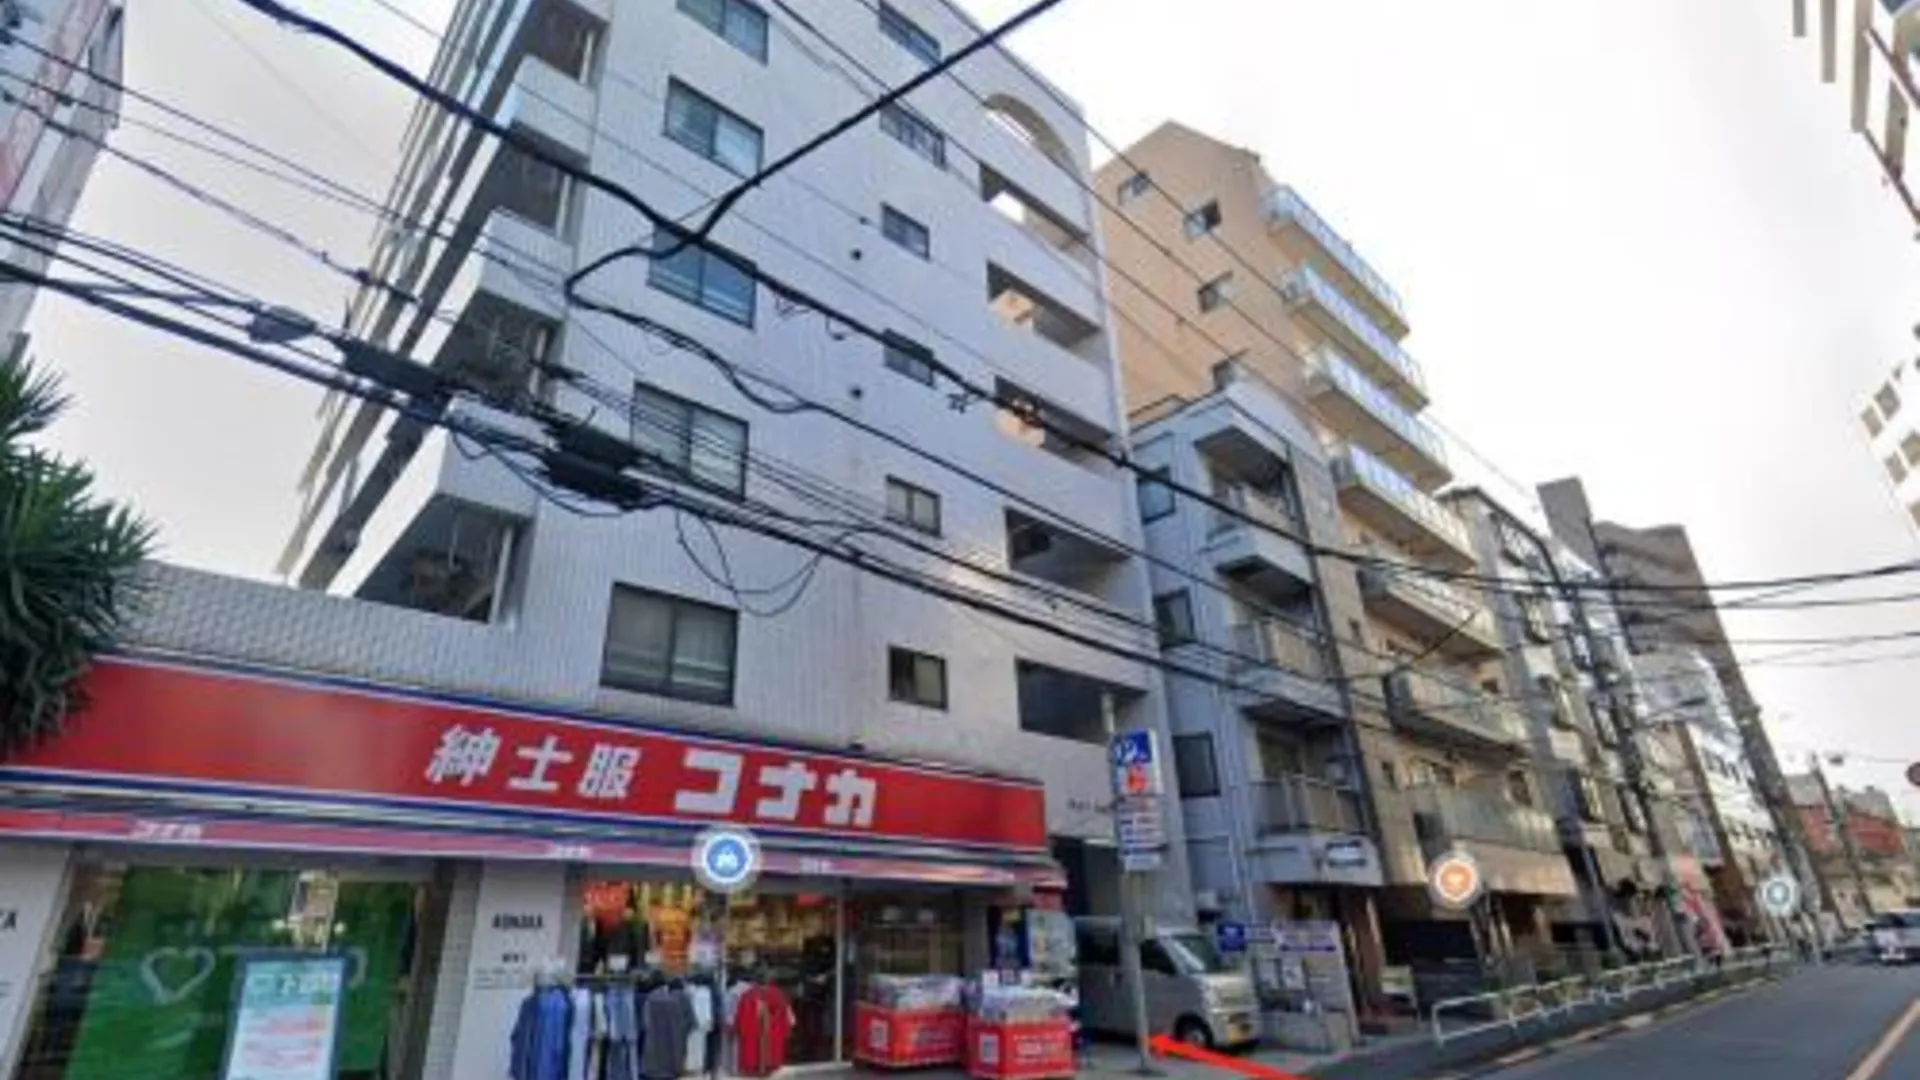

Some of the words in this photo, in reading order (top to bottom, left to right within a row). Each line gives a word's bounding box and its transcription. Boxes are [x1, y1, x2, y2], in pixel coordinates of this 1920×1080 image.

[425, 723, 641, 800] 紳士服
[674, 748, 878, 828] コナカ
